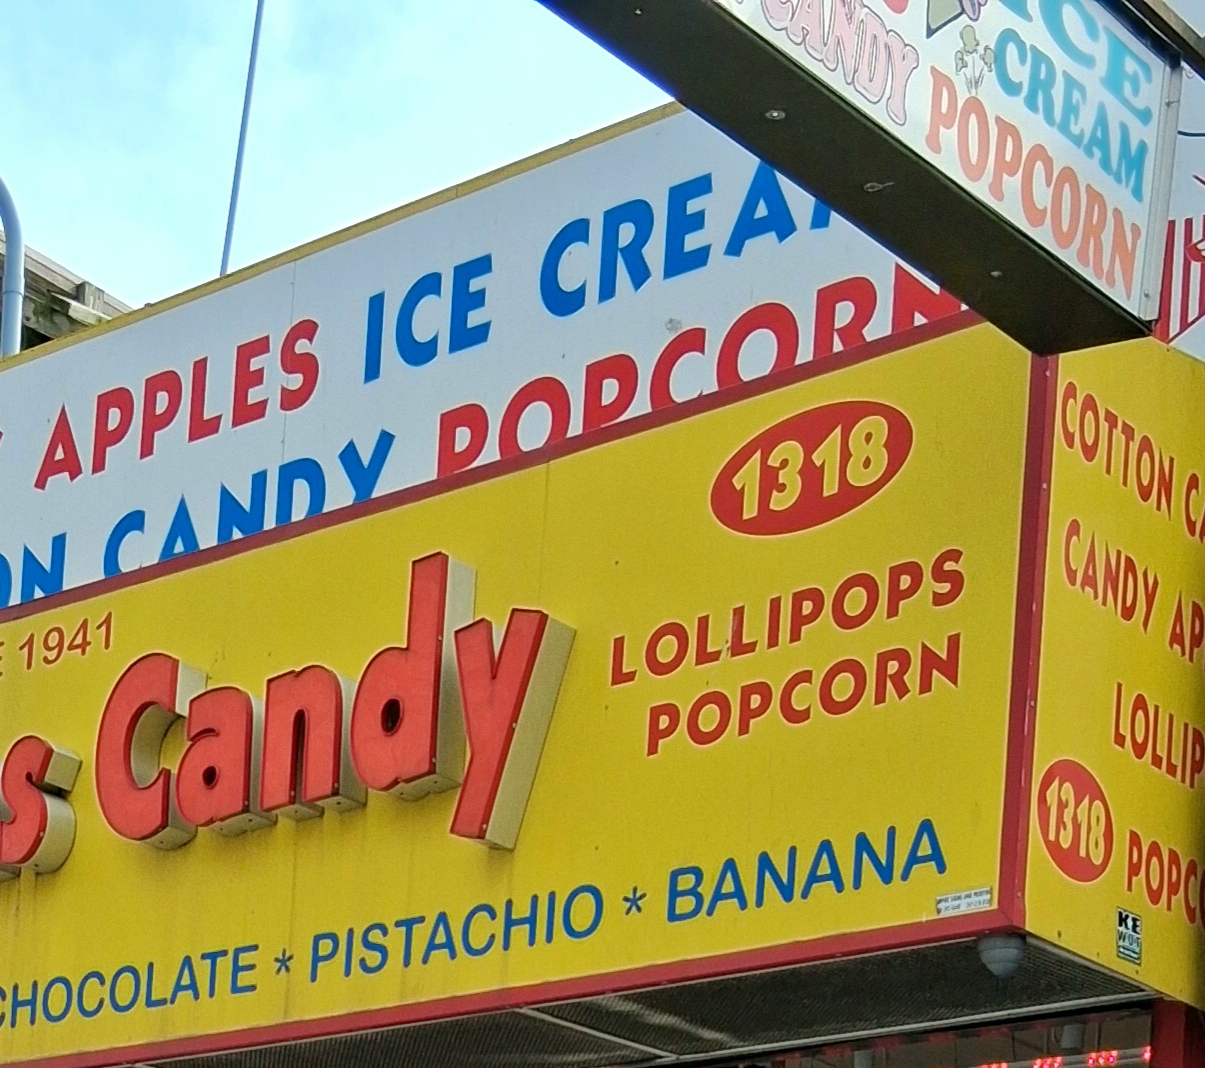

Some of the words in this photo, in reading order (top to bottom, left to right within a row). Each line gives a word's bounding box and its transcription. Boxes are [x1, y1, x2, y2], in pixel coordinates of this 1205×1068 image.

[925, 66, 1141, 300] POPCORN
[994, 28, 1148, 203] CREAM
[35, 318, 319, 491] APPLES
[364, 253, 492, 384] ICE
[540, 160, 832, 317] CREA
[104, 429, 395, 579] CANDY
[732, 415, 889, 521] 1318
[1061, 380, 1175, 522] COTTON
[18, 611, 114, 673] 1941
[610, 547, 965, 687] LOLLIPOPS
[1064, 518, 1159, 635] CANDY
[95, 551, 569, 848] Candy
[646, 632, 962, 758] POPCORN
[1046, 776, 1106, 866] 1318
[308, 883, 604, 983] PISTACHIO
[666, 818, 948, 924] BANANA
